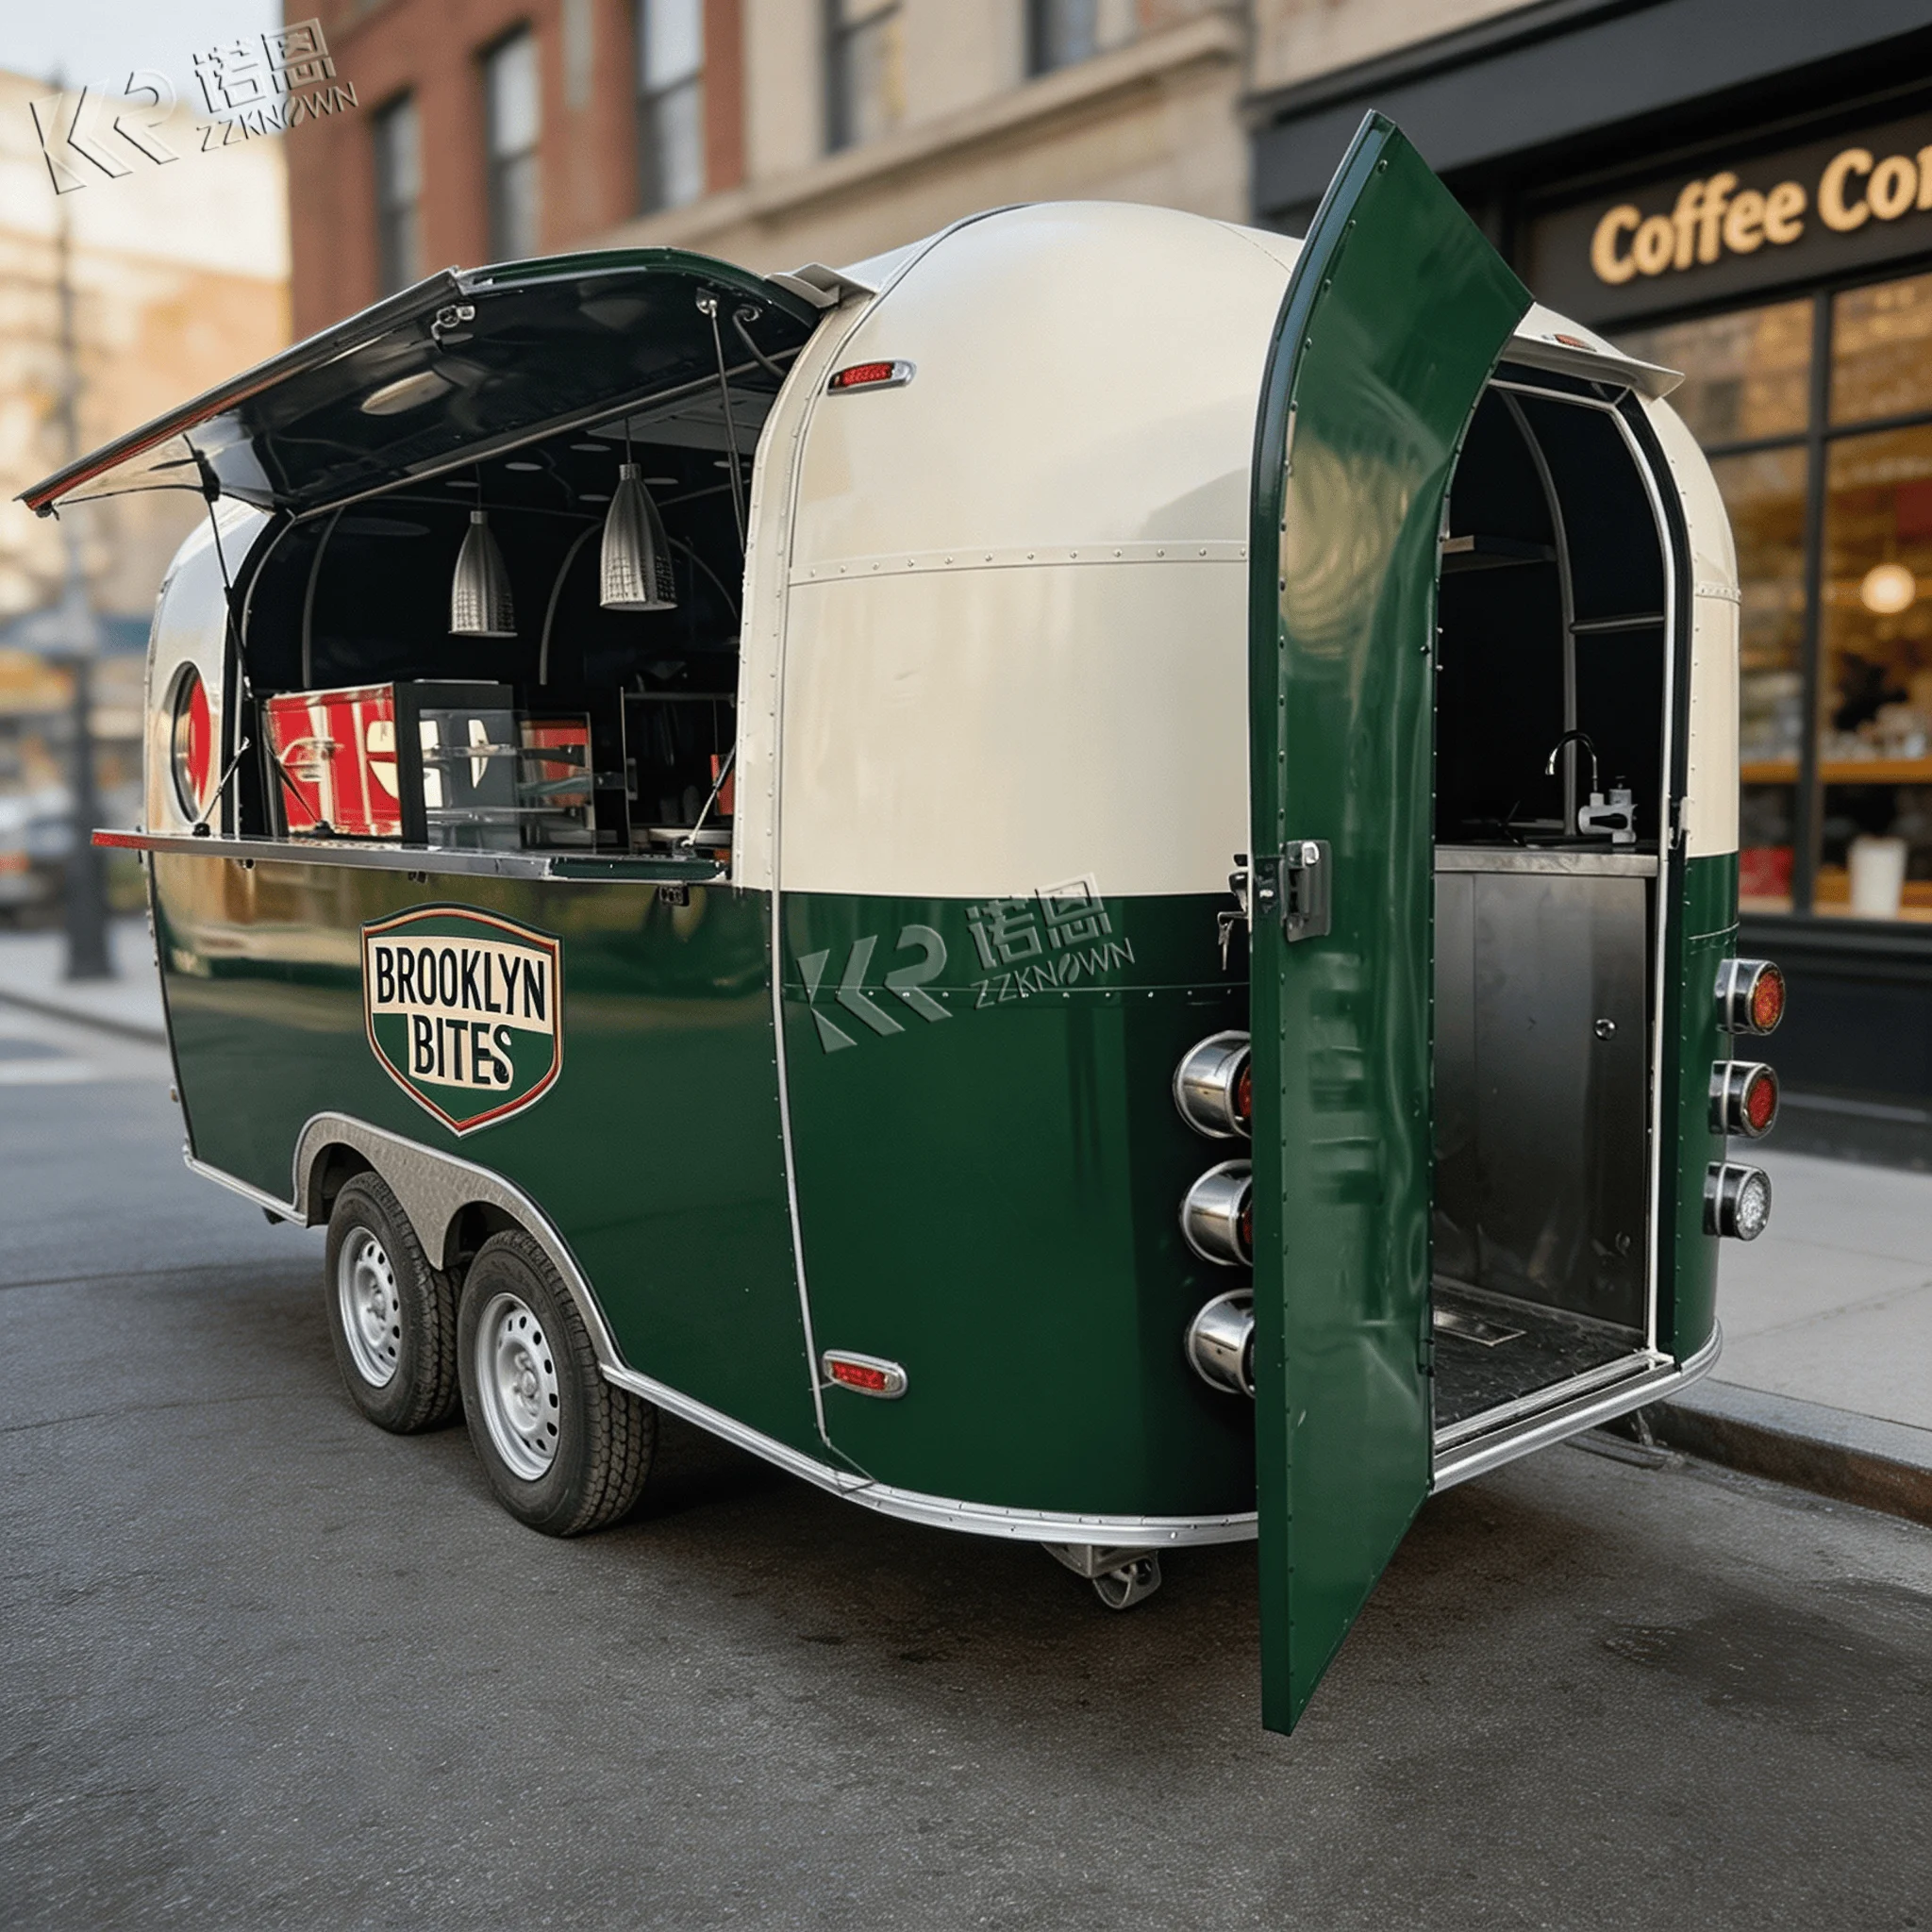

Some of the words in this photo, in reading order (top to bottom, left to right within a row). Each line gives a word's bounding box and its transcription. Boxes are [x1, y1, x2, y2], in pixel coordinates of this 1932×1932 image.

[1590, 171, 1807, 285] Coffee
[375, 946, 546, 1022] BROOKLYN
[412, 1014, 513, 1085] BITES
